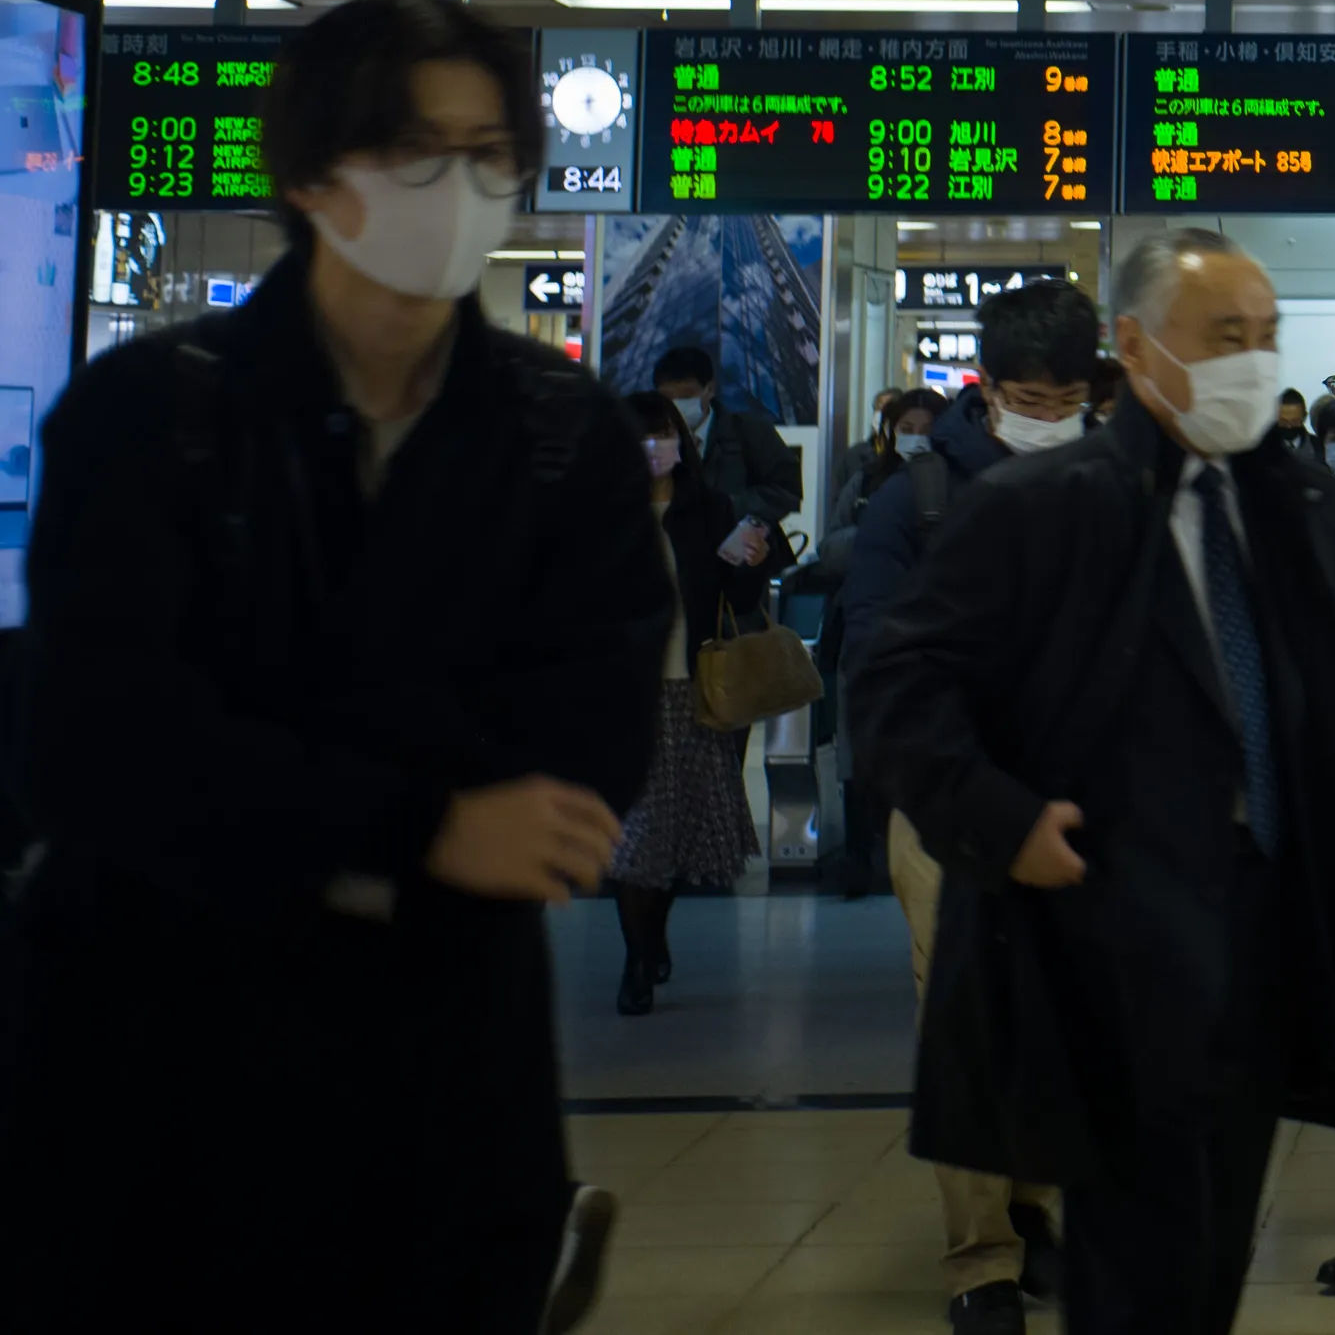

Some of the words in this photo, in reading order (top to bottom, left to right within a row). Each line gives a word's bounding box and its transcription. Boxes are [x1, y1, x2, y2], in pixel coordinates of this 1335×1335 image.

[674, 37, 968, 59] 岩見沢・旭川・網走・稚内方面
[133, 62, 199, 85] 8:48
[216, 61, 247, 74] NEW
[674, 64, 719, 90] 普通
[869, 66, 932, 91] 8:52
[950, 67, 995, 91] 江別
[1154, 68, 1200, 93] 普通
[674, 95, 848, 115] この列車は6両編成です。
[1154, 98, 1326, 117] この列車は6両編成です。
[132, 117, 196, 141] 9:00
[213, 116, 244, 129] NEW
[671, 120, 780, 145] 特急カムイ
[869, 120, 932, 145] 9:00
[950, 121, 995, 145] 旭川
[1154, 122, 1198, 147] 普通
[130, 145, 194, 169] 9:12
[212, 144, 243, 157] NEW
[671, 147, 717, 172] 普通
[868, 147, 931, 172] 9:10
[949, 148, 1017, 172] 岩見沢
[1152, 149, 1266, 174] 快速エアポート
[129, 172, 192, 196] 9:23
[211, 172, 241, 185] NEW
[211, 184, 271, 197] AIRPOR
[563, 166, 622, 192] 8:44
[671, 174, 716, 199] 普通
[868, 175, 929, 200] 9:22
[947, 175, 992, 199] 江別
[1152, 177, 1197, 201] 普通
